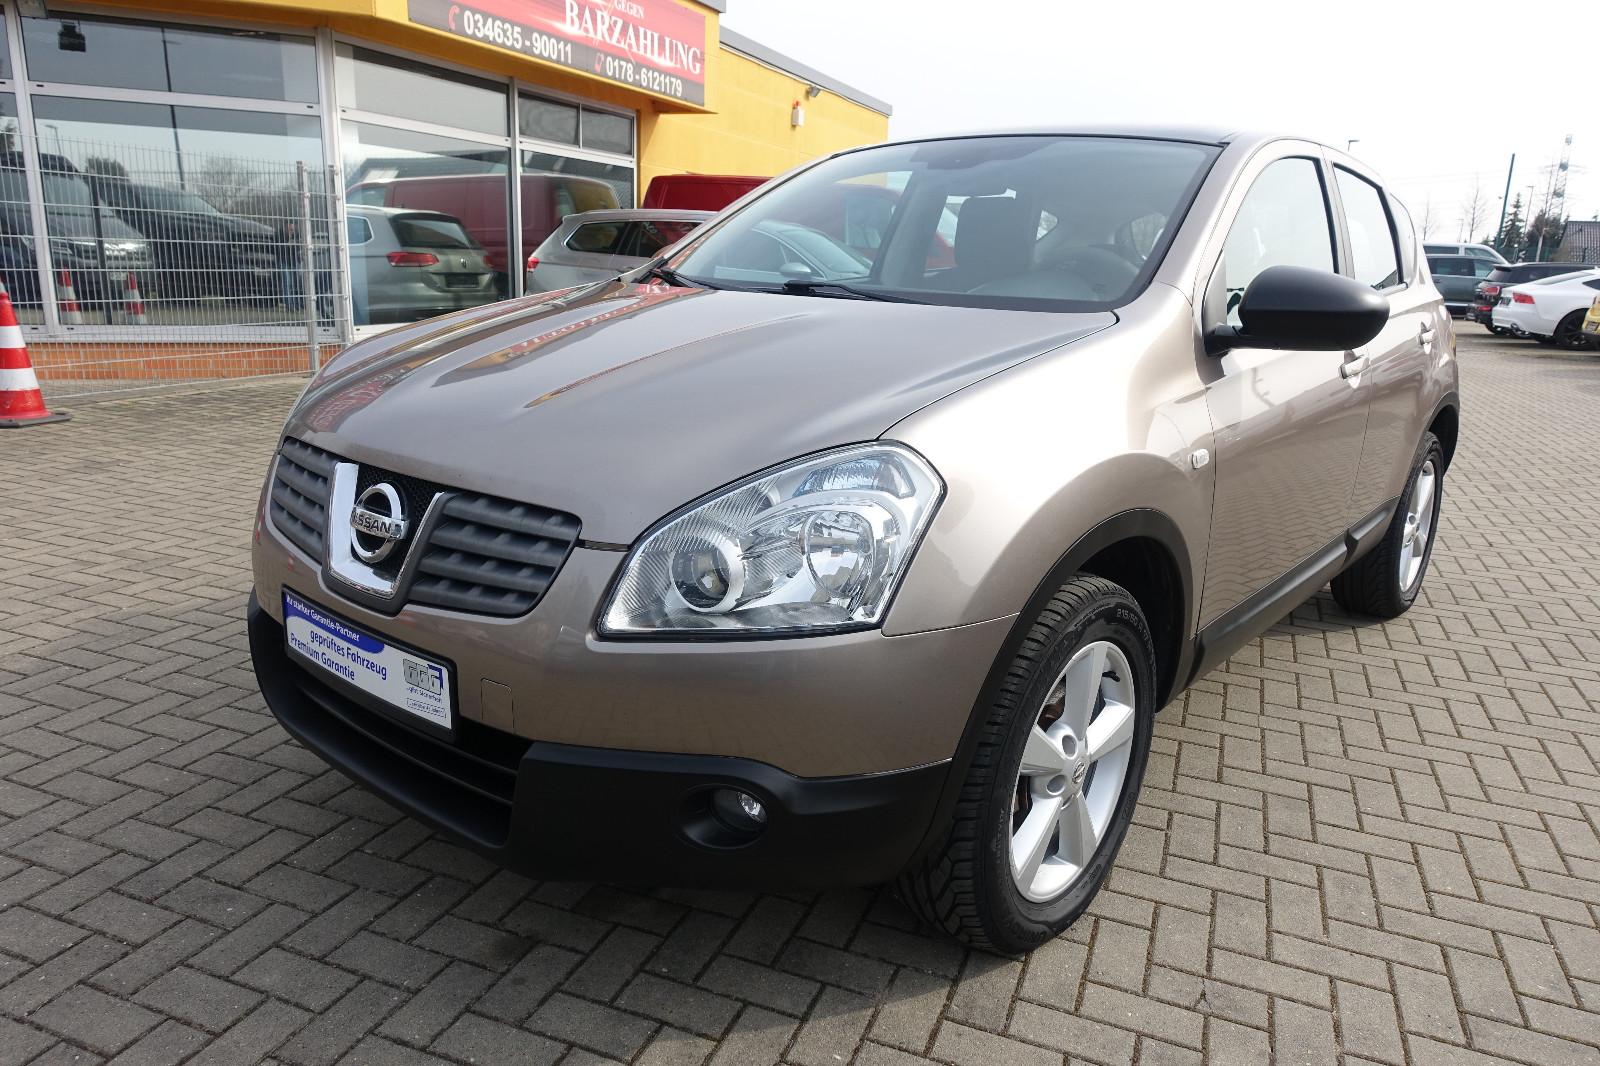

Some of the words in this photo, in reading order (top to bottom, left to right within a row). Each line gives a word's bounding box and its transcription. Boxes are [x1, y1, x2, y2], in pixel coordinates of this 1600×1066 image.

[615, 0, 645, 19] GEGEN
[564, 0, 701, 75] BARZAHLUNG
[290, 632, 320, 660] Premium
[321, 652, 355, 681] Garantie
[310, 630, 345, 658] geprüftes
[346, 647, 387, 681] Fahrzeug
